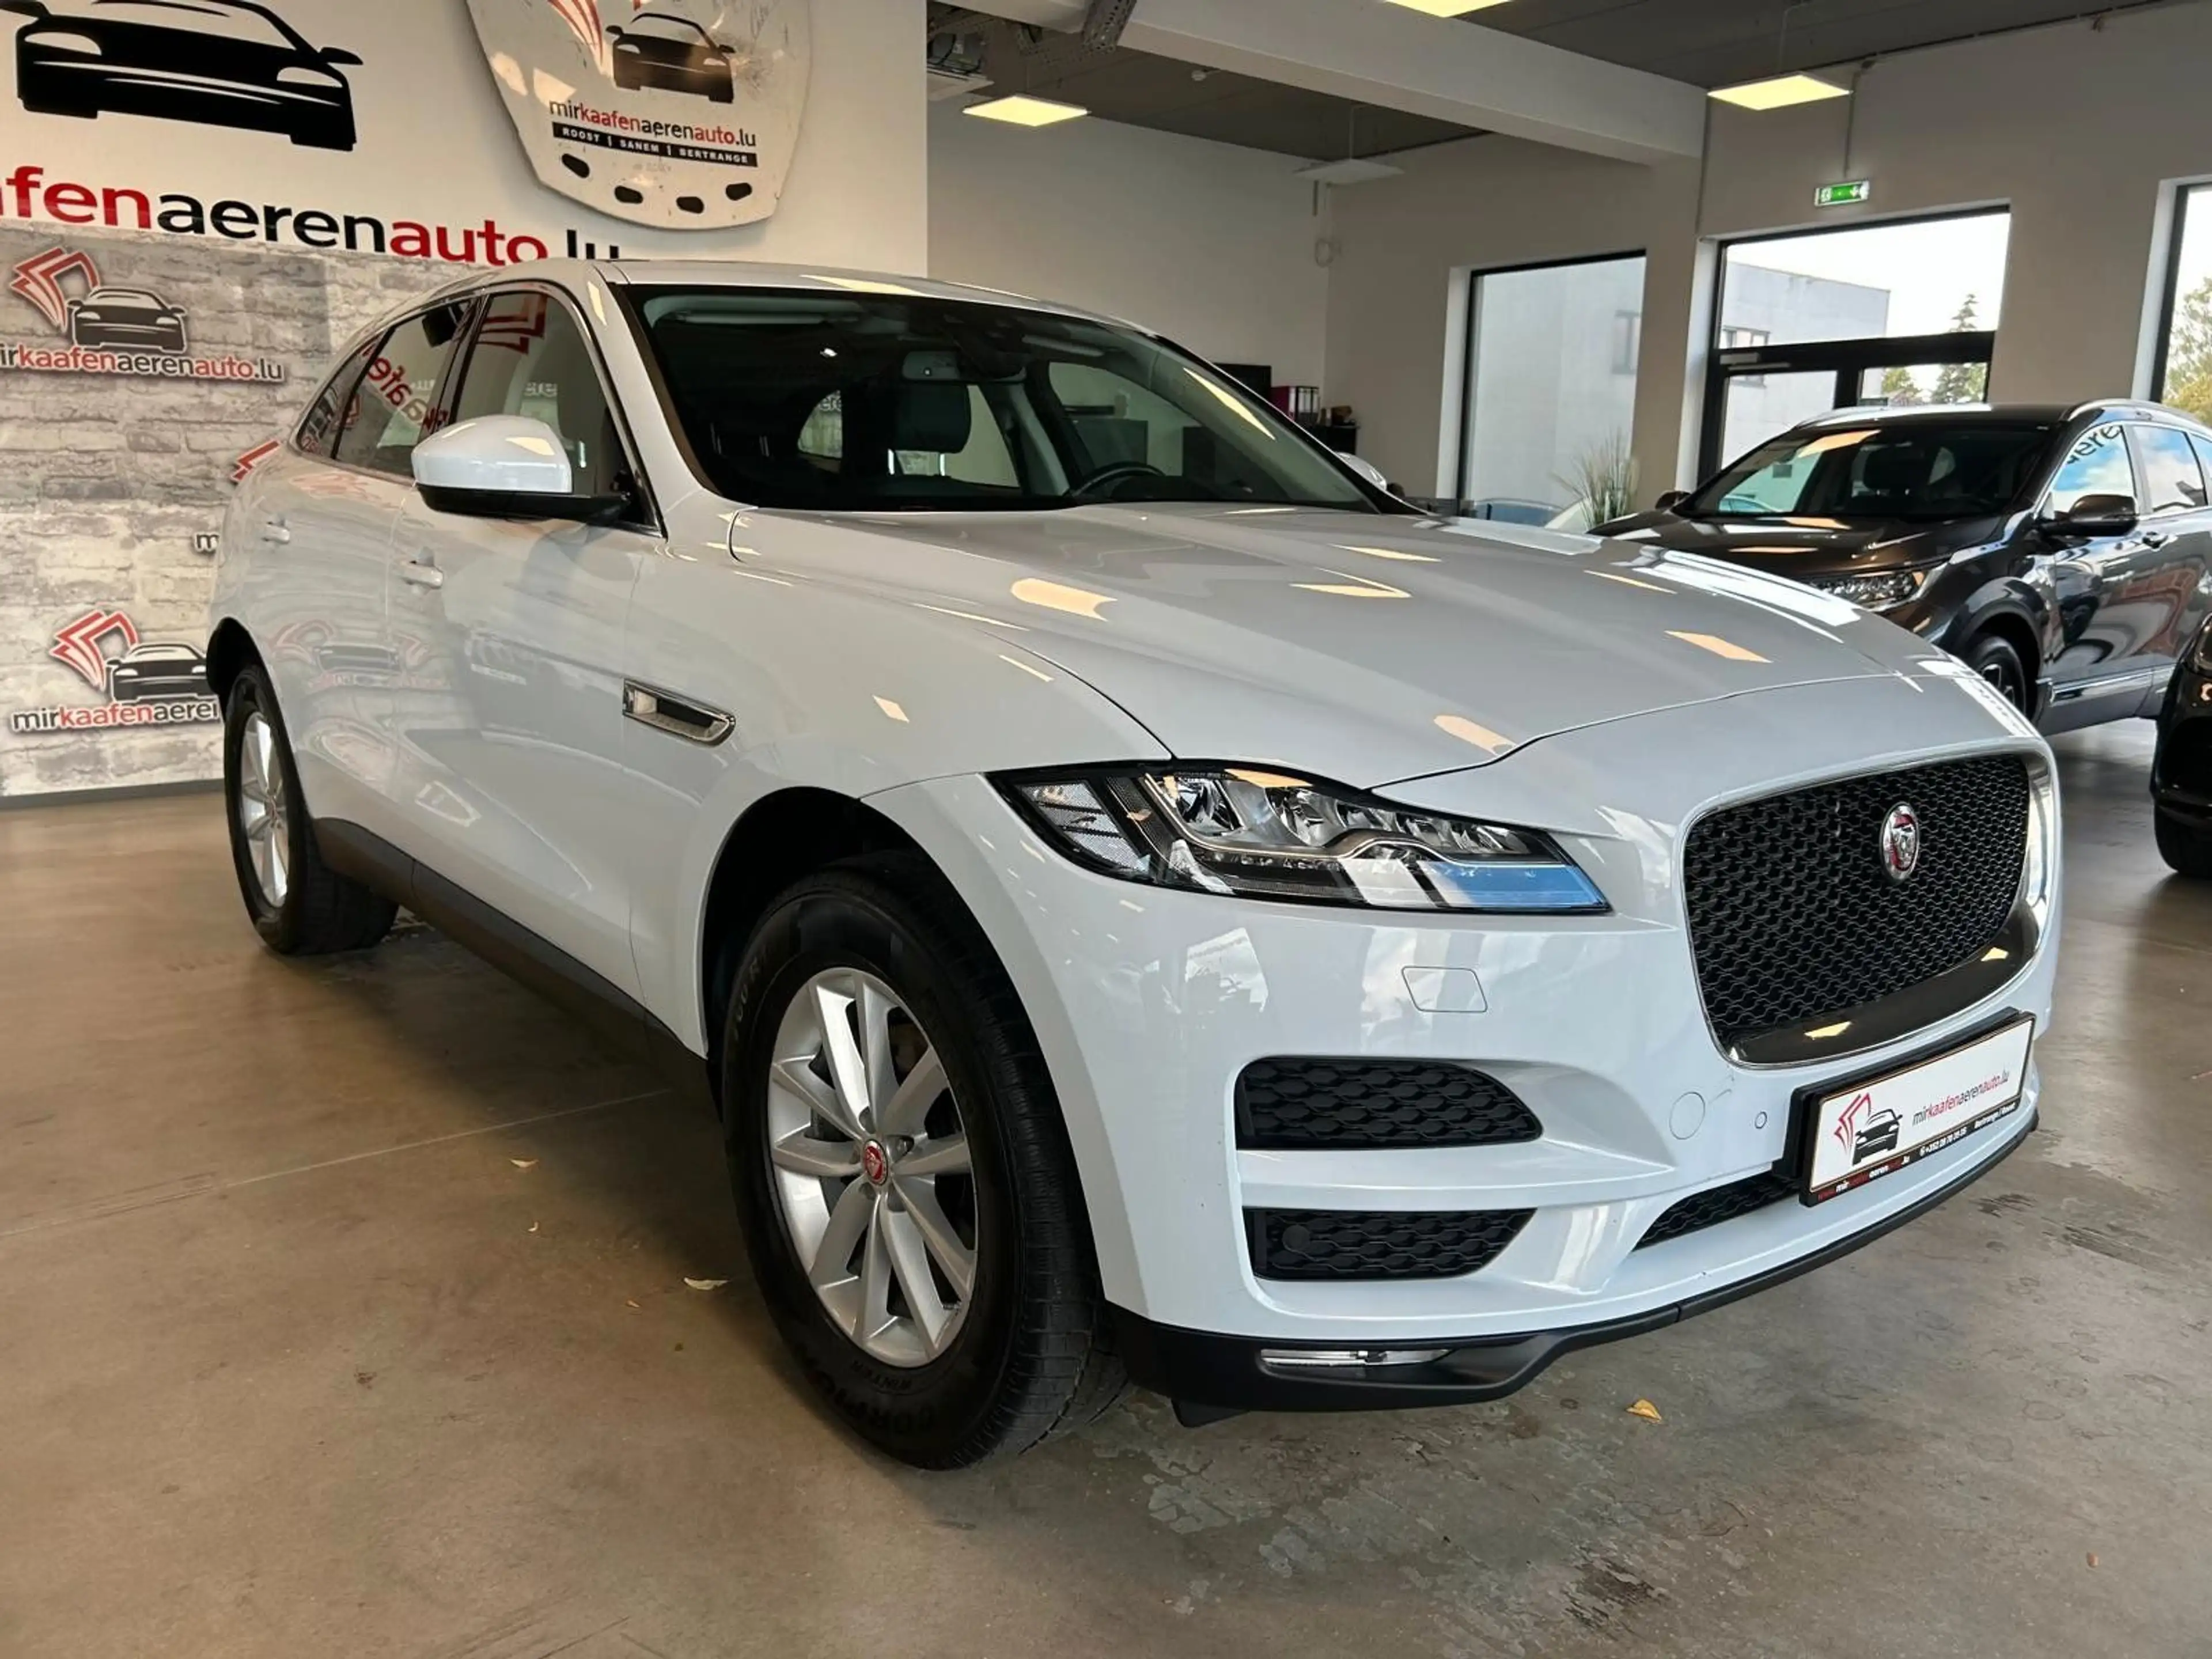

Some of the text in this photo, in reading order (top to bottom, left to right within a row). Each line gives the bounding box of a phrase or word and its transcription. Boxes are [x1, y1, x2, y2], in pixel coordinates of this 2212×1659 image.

[550, 100, 756, 146] mirkaafenaerenauto.lu
[562, 127, 600, 143] ROOST
[619, 139, 660, 153] SANEM
[679, 148, 748, 164] BERTRANGE
